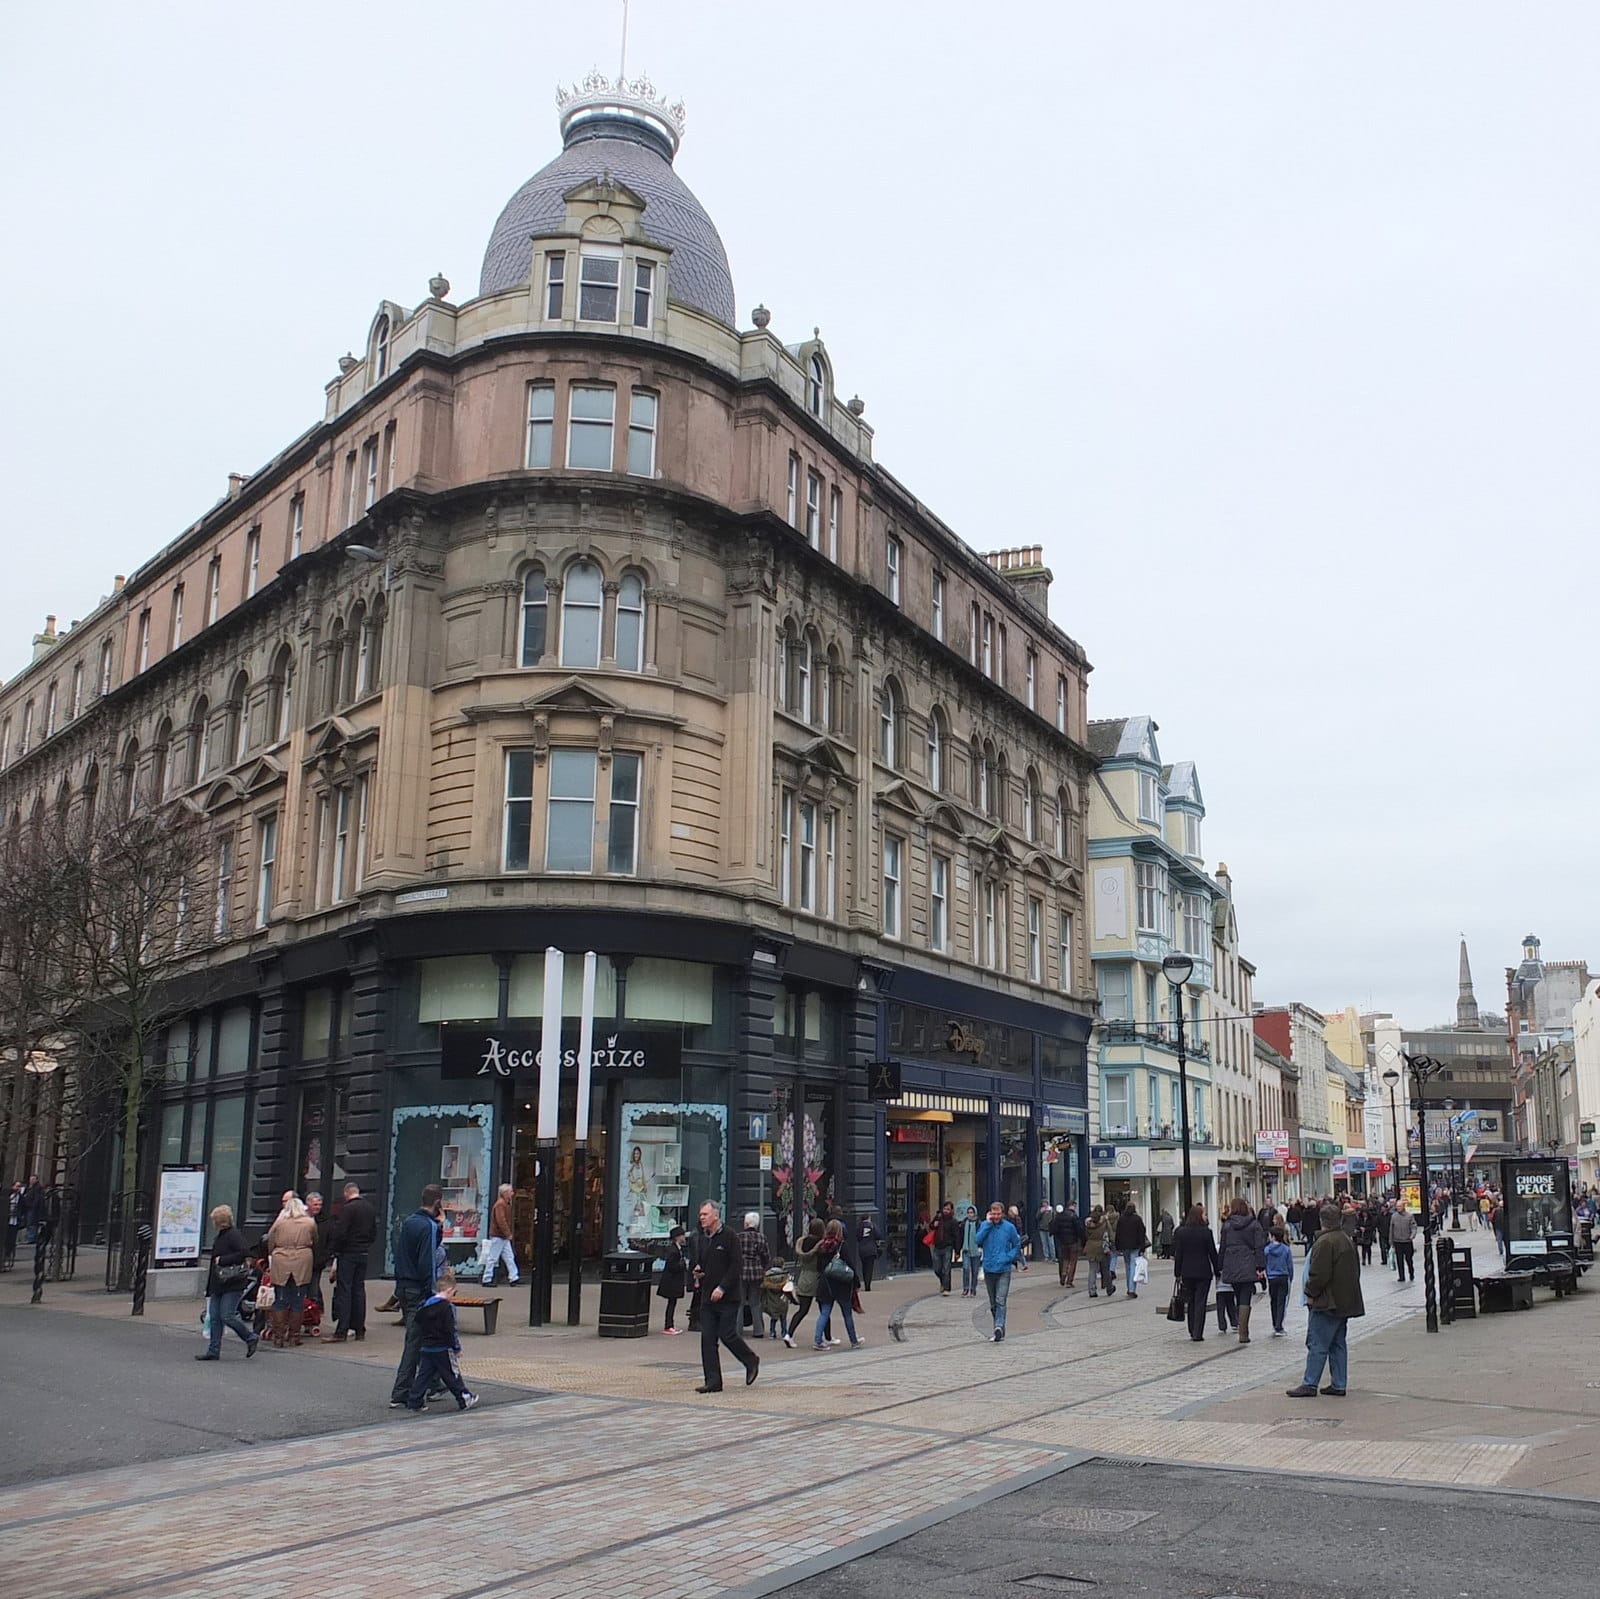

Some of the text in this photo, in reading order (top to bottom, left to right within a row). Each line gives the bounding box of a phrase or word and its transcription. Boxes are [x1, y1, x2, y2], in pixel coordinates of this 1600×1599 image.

[477, 1034, 646, 1076] Accesrize
[874, 1064, 895, 1089] A
[1256, 1131, 1287, 1139] TO LET
[1516, 1174, 1555, 1185] CHOOSE
[1516, 1183, 1556, 1195] PEACE
